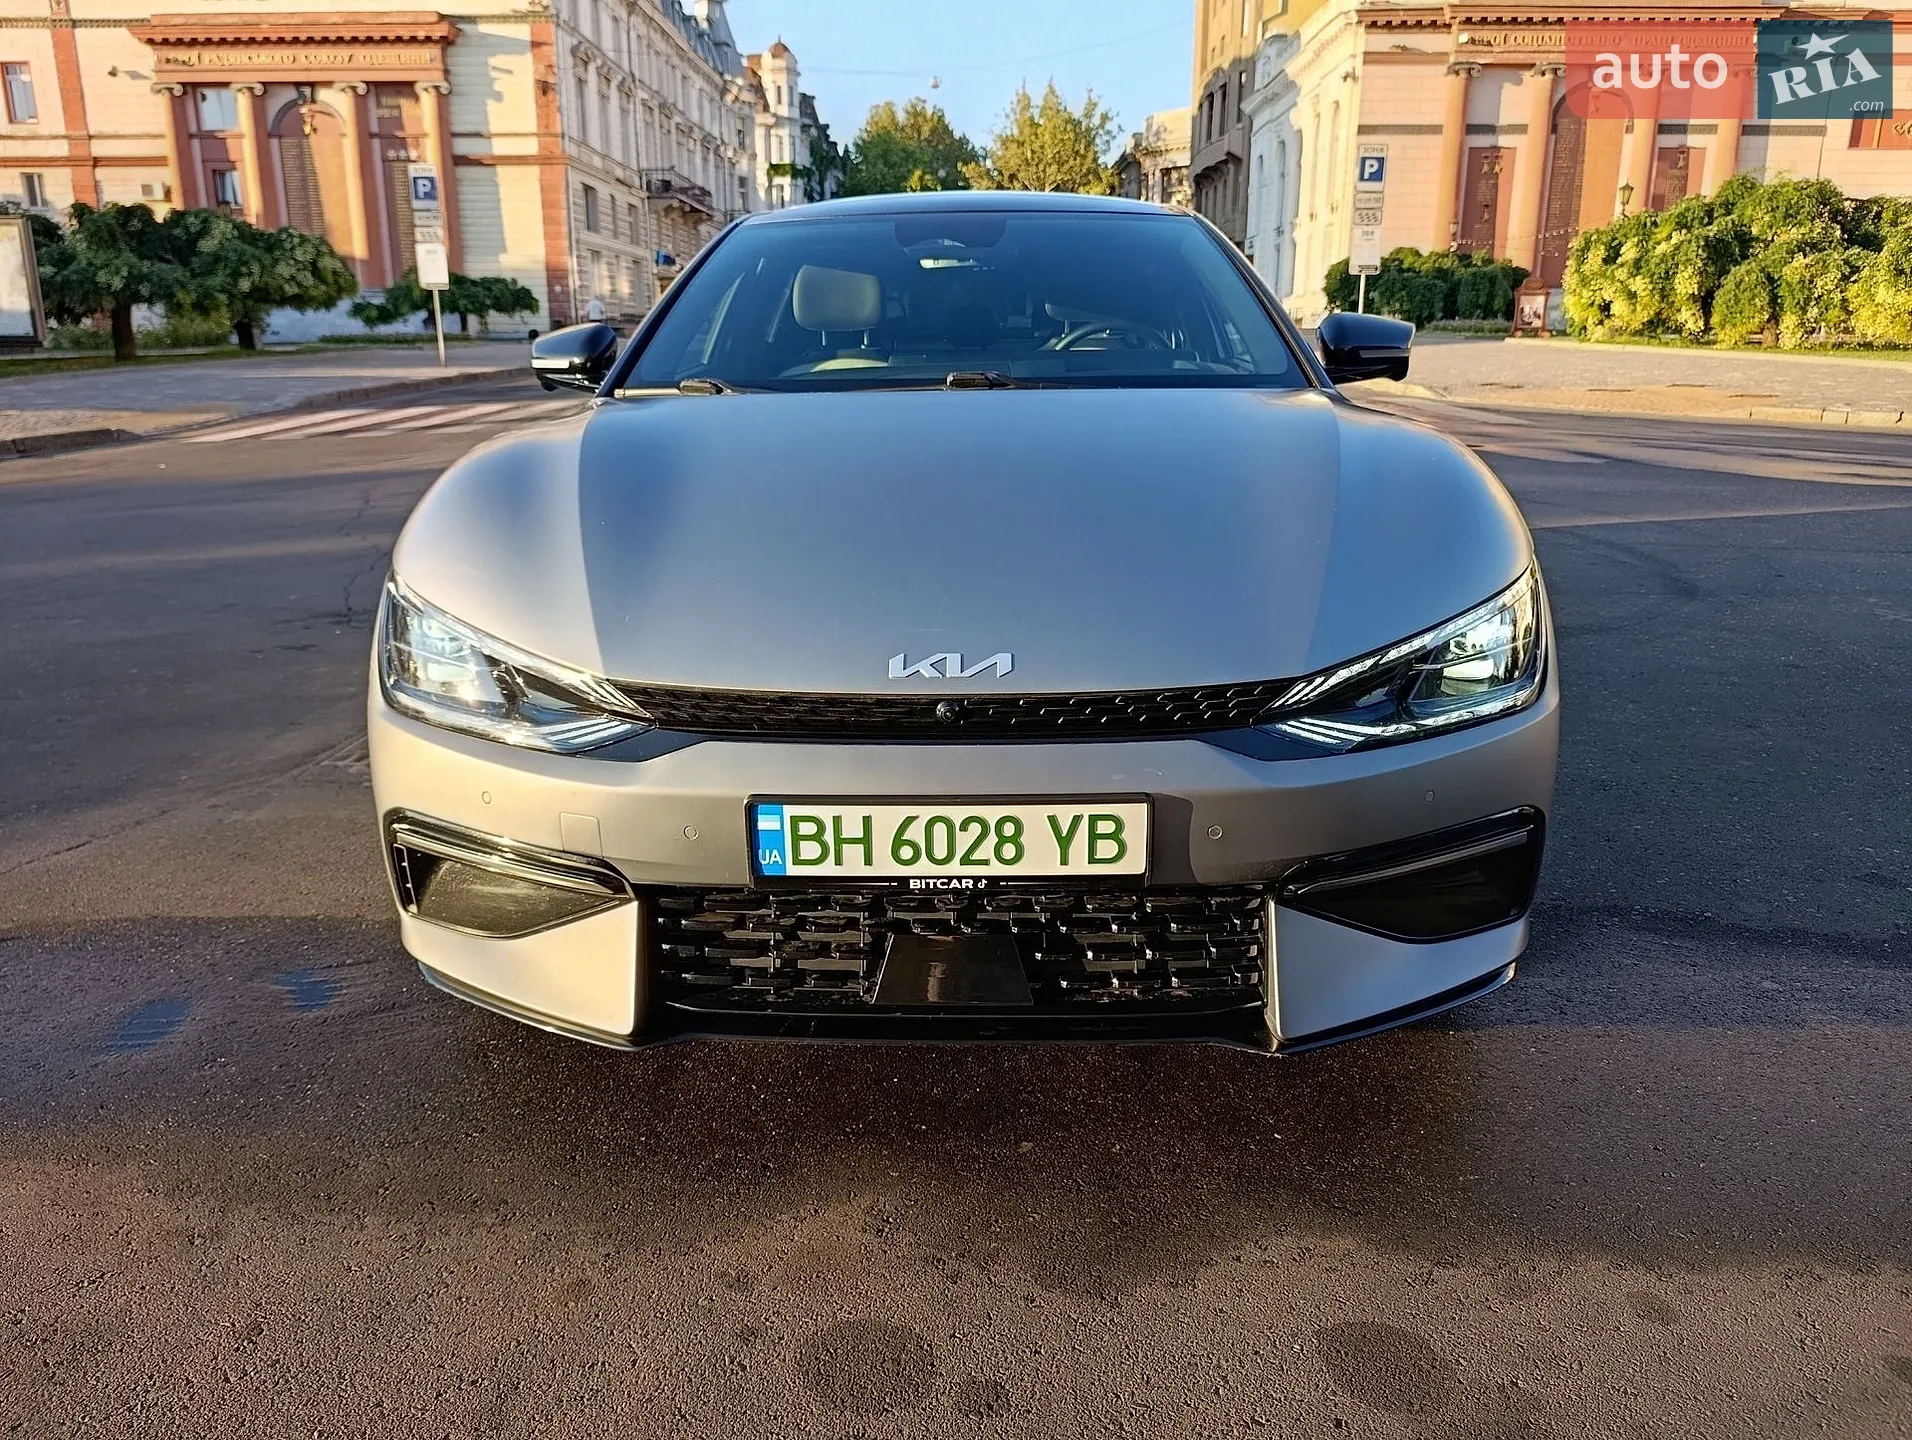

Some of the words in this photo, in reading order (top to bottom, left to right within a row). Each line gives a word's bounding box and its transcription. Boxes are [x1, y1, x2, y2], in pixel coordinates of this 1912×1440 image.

[888, 652, 1014, 679] KIA
[790, 815, 873, 866] BH
[891, 815, 1024, 866] 6028
[1047, 814, 1127, 866] YB
[759, 849, 782, 865] UA
[909, 878, 973, 889] BITCAR
